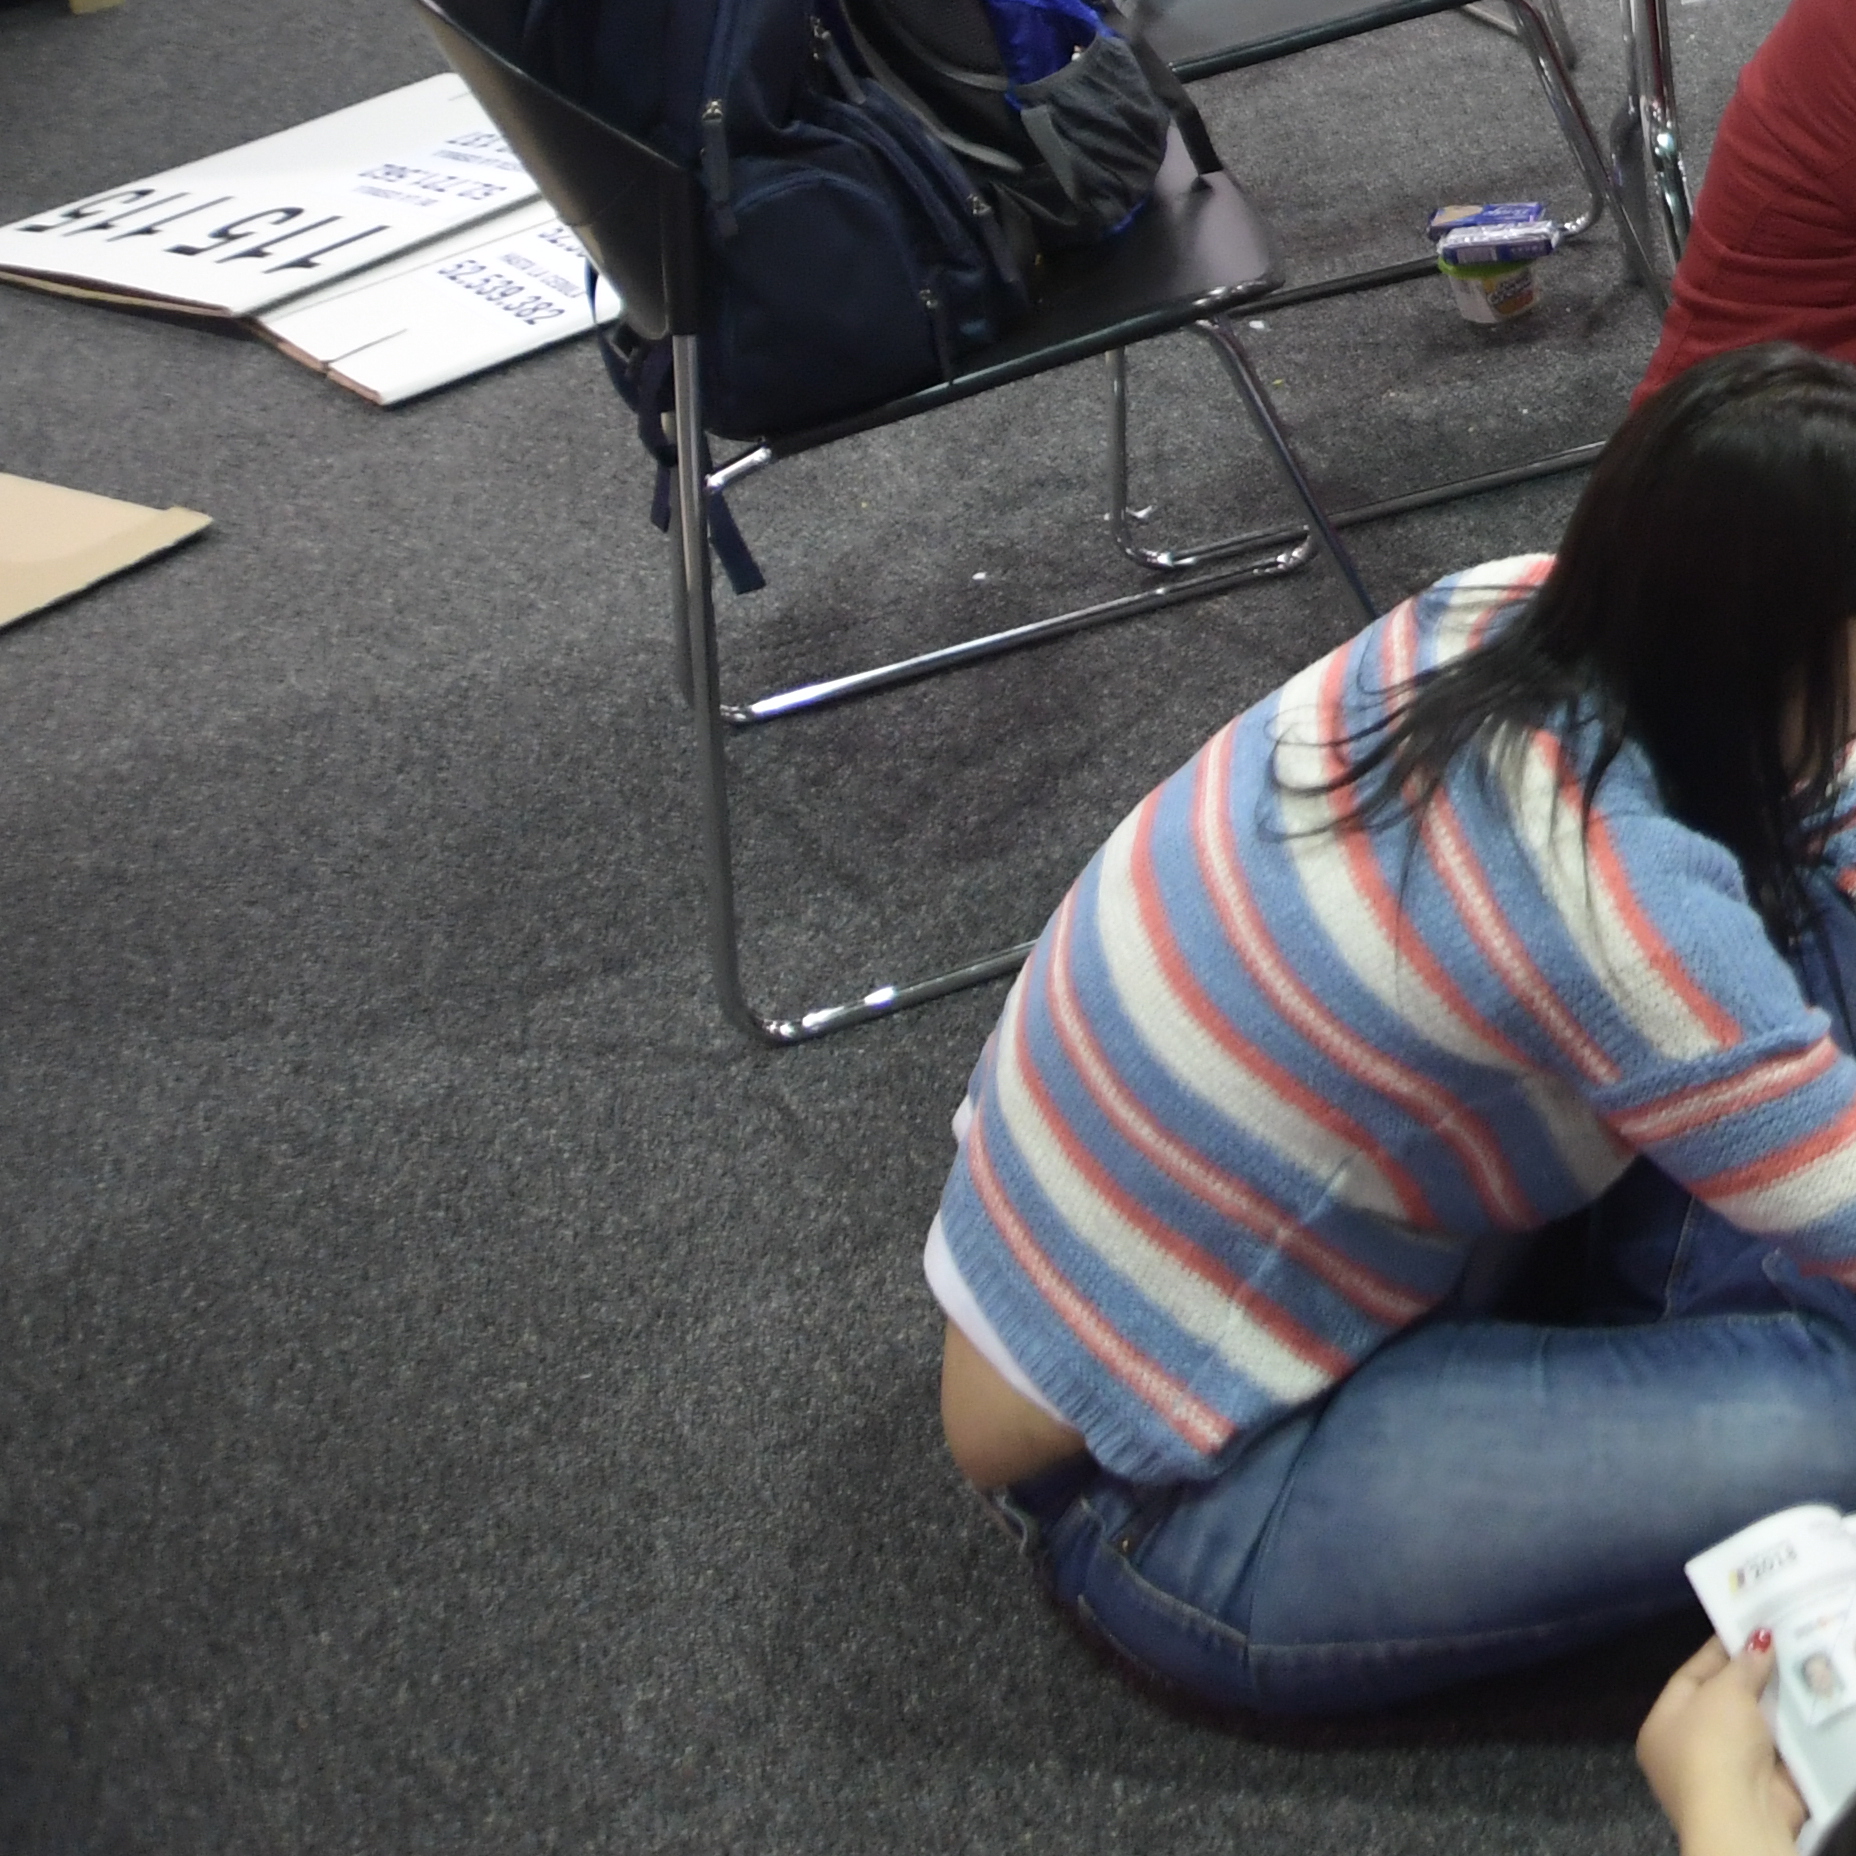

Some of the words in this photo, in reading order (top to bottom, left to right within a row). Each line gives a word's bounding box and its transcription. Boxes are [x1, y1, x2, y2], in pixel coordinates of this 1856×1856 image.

[15, 188, 235, 244] 115
[166, 205, 390, 275] 115
[436, 259, 566, 326] 52.539.382
